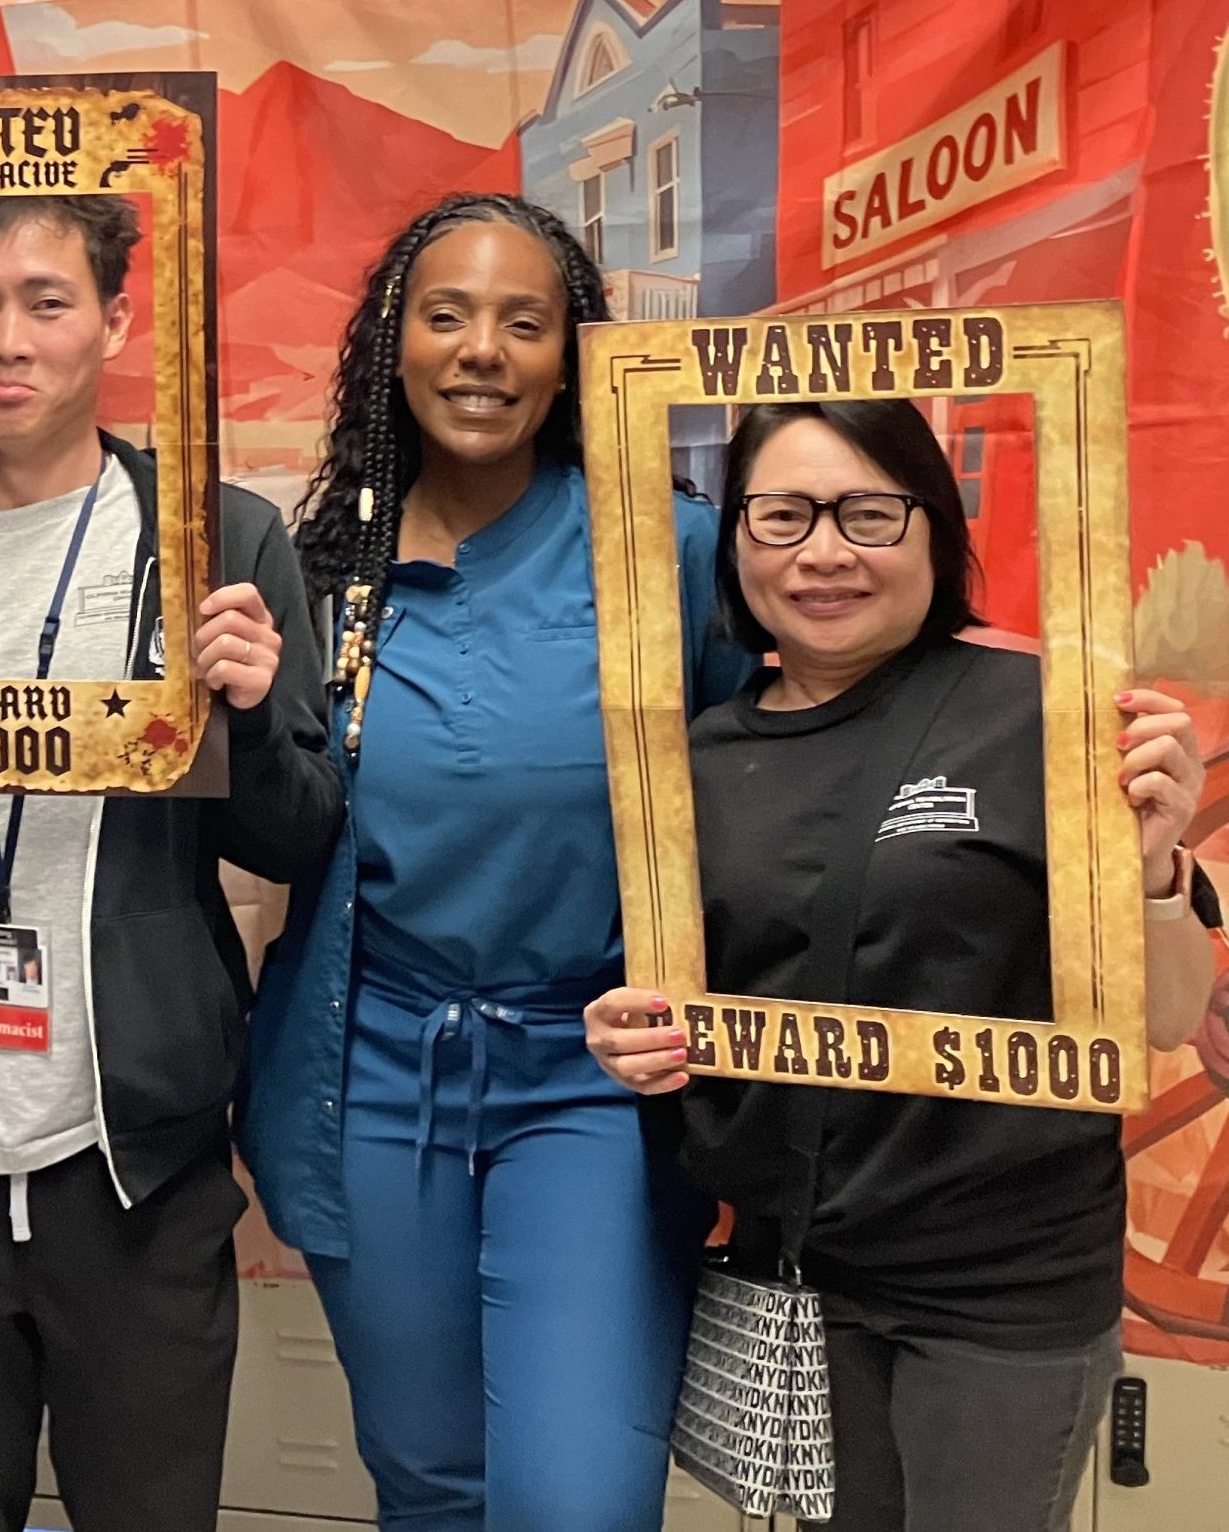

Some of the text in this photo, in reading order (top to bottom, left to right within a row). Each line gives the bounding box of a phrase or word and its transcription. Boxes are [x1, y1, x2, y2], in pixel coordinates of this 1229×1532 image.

[833, 76, 1041, 249] SALOON
[692, 317, 1003, 396] WANTED
[932, 1026, 1120, 1103] $1000
